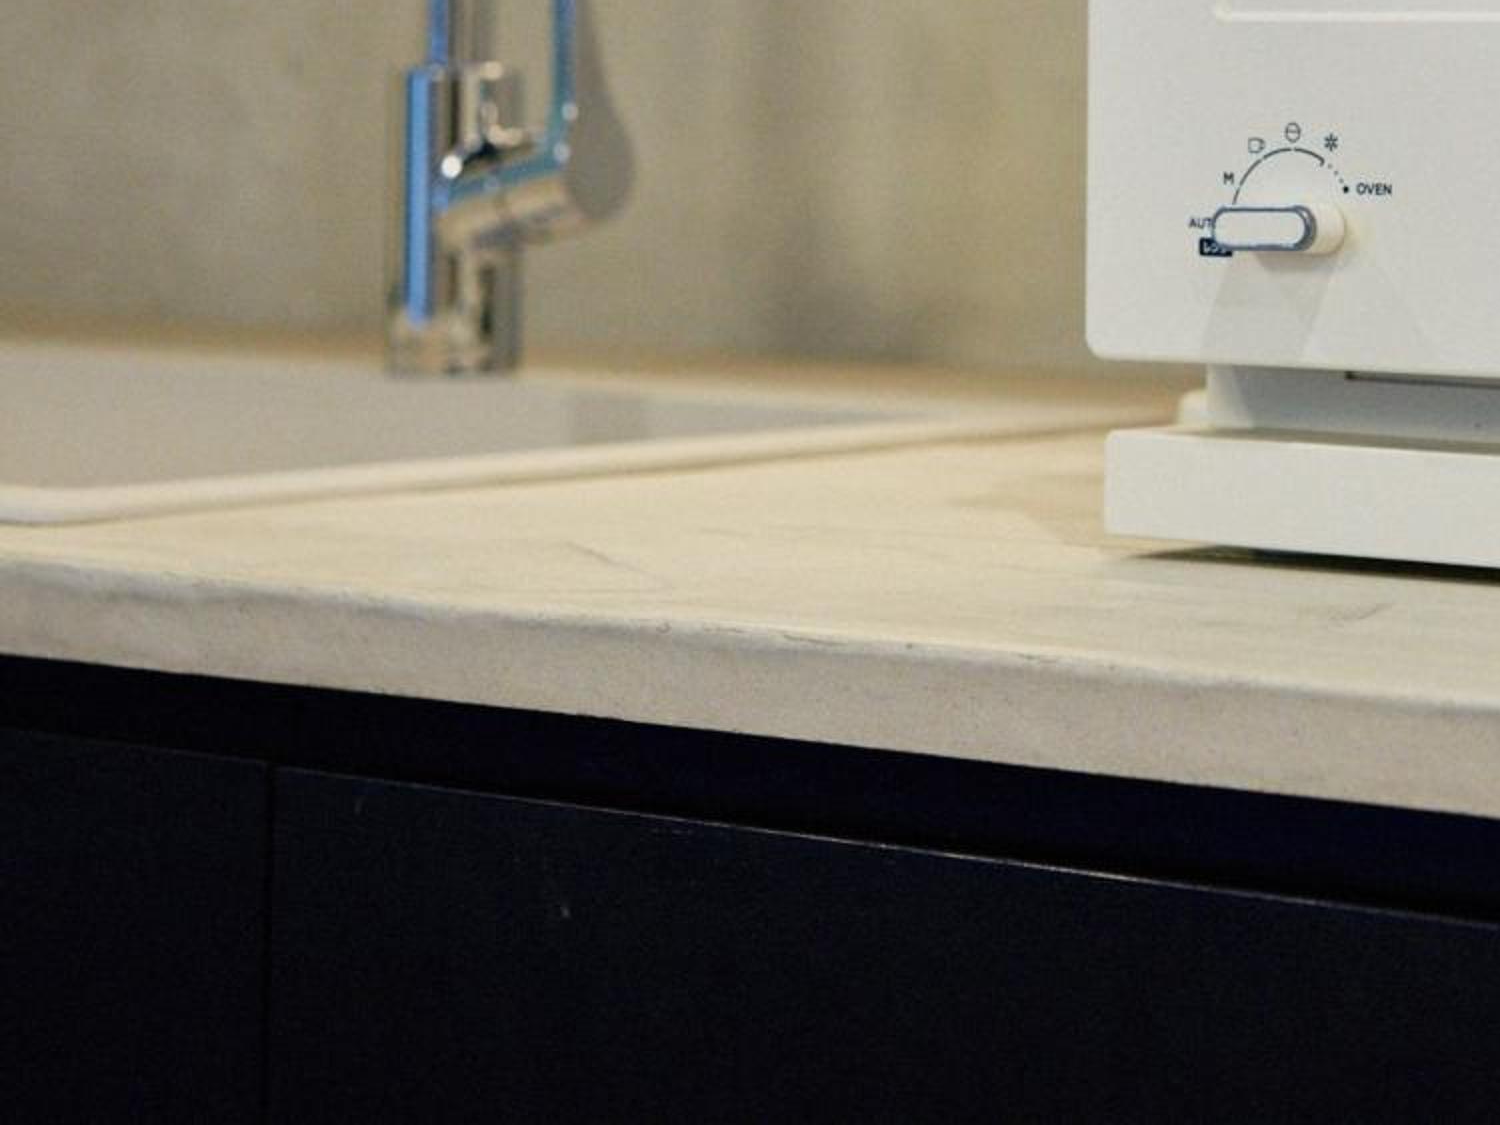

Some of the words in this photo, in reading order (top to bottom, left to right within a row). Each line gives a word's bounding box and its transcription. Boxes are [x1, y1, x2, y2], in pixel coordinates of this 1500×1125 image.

[1223, 172, 1235, 185] M
[1356, 182, 1392, 196] OVEN
[1188, 217, 1214, 229] AUT
